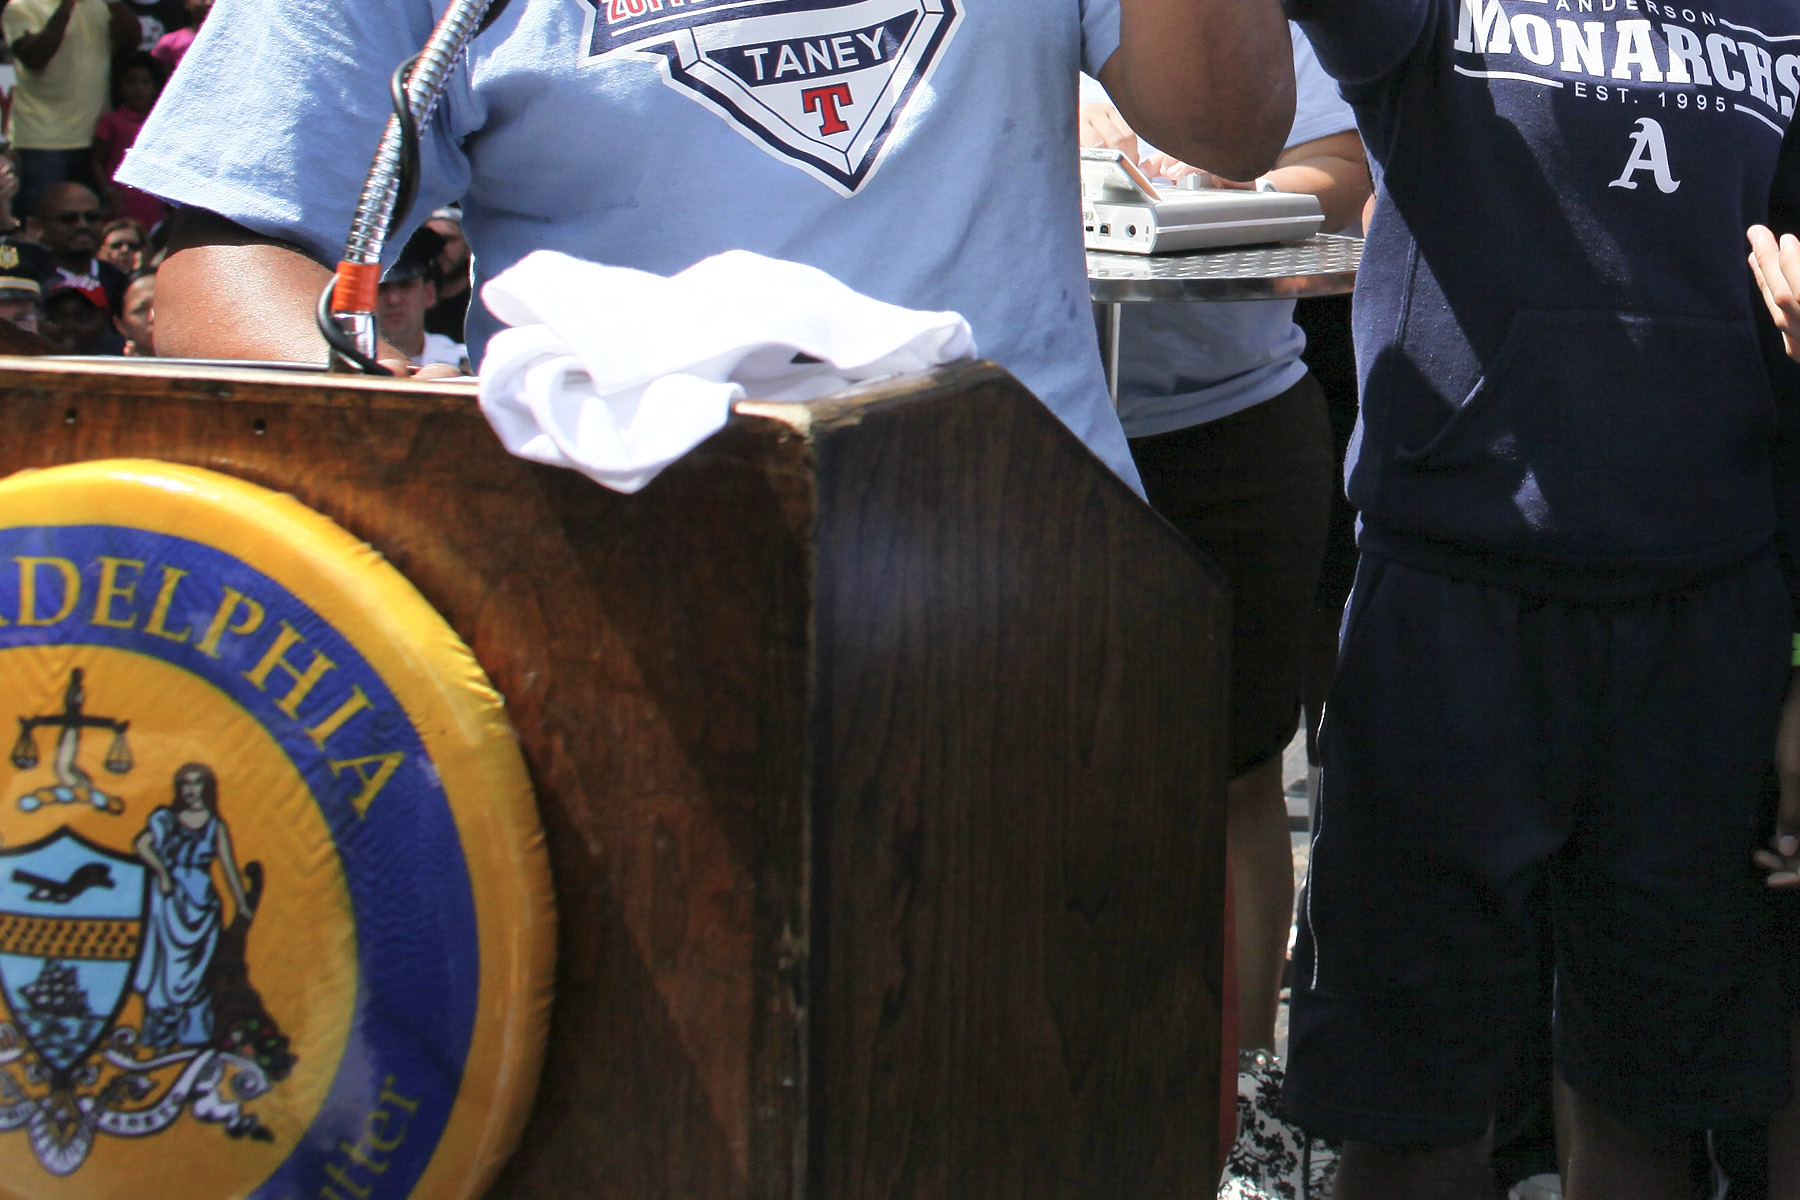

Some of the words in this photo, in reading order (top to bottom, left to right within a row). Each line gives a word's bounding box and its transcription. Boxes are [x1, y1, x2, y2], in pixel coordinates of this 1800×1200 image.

[744, 26, 886, 81] TANEY
[800, 81, 855, 138] T
[1574, 81, 1639, 103] EST.
[1657, 92, 1727, 113] 1995
[1608, 117, 1681, 194] A
